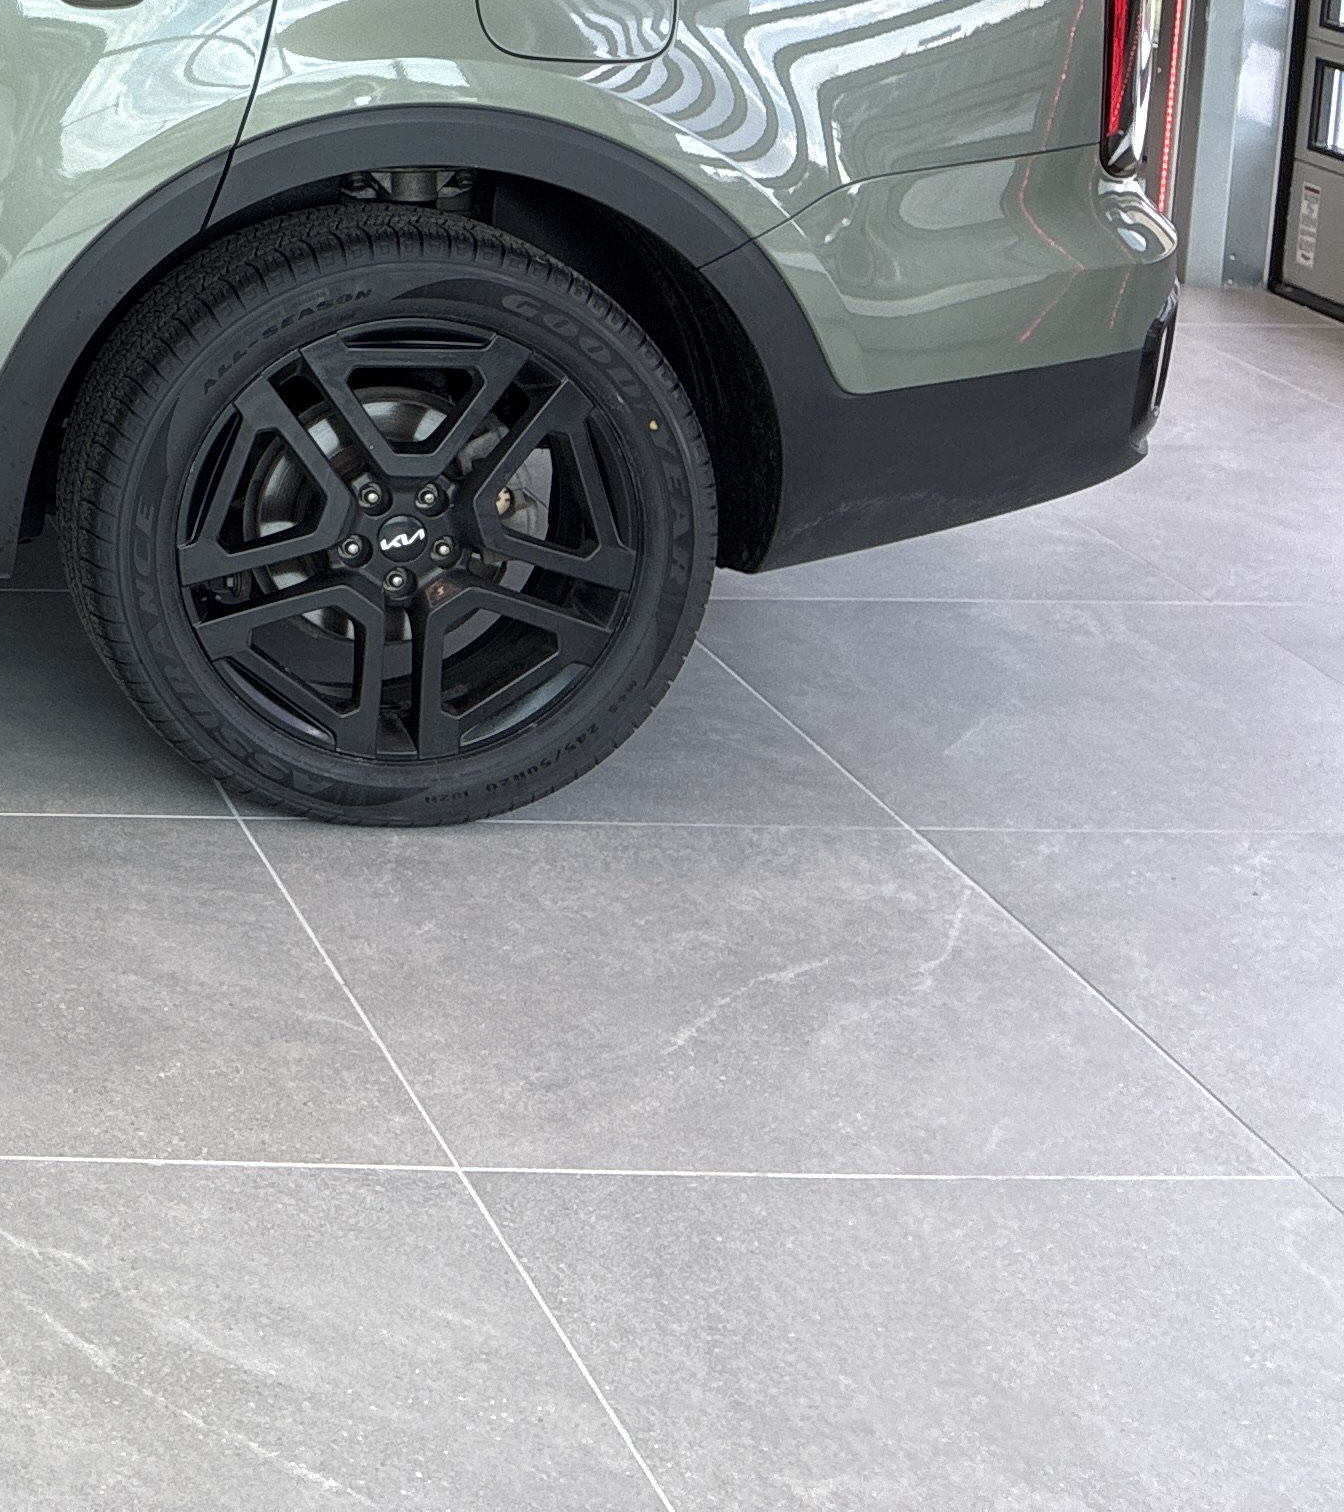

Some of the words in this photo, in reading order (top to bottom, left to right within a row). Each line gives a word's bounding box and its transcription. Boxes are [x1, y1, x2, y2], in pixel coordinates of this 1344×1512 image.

[203, 288, 373, 395] ALL-SEASON
[501, 294, 691, 582] GOODYEAR
[379, 528, 426, 551] KIA
[133, 494, 334, 794] ASSURANCE
